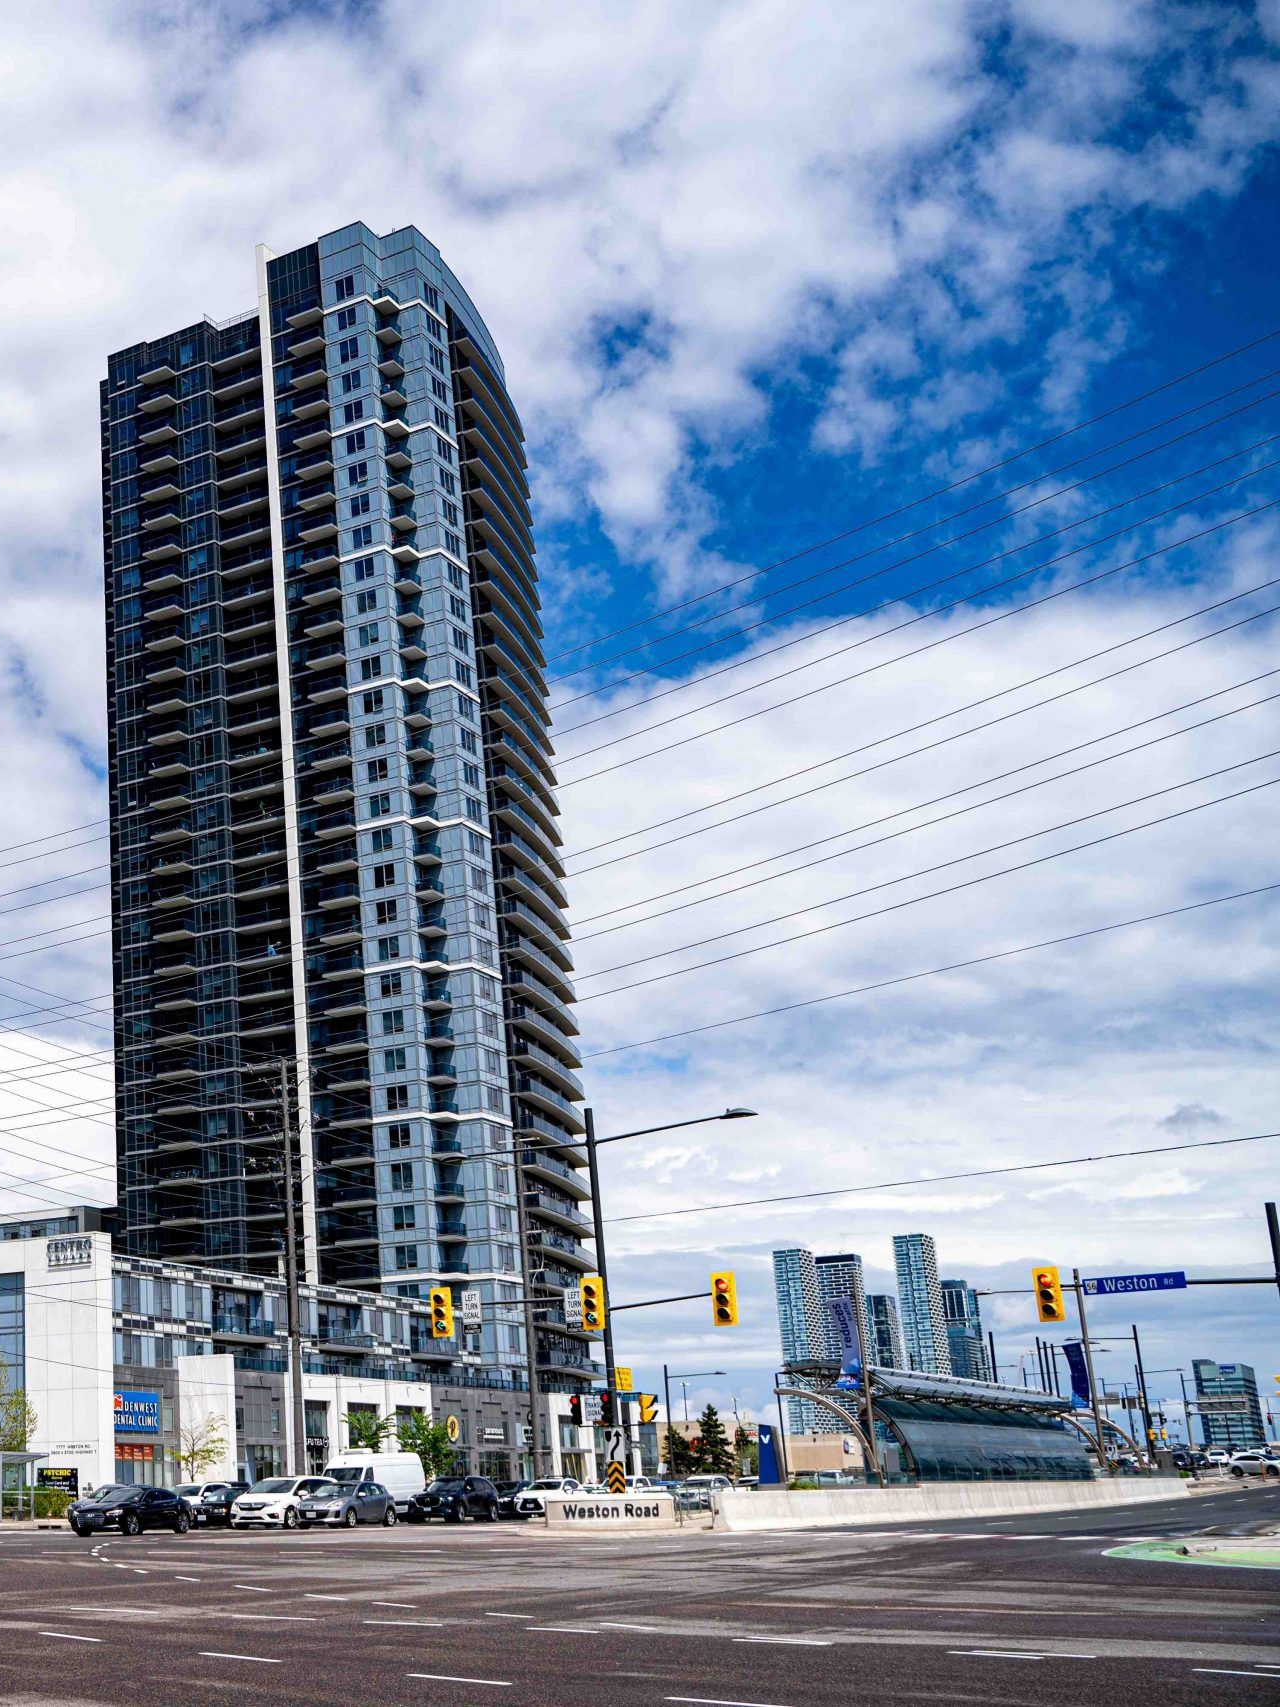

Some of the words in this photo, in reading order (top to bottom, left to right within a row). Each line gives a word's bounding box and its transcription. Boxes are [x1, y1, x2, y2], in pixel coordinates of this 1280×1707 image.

[47, 1239, 92, 1253] CENTRO
[1103, 1276, 1158, 1292] Weston
[1163, 1277, 1174, 1286] Rd
[465, 1293, 477, 1302] LEFT
[567, 1291, 580, 1299] LEFT
[465, 1303, 479, 1311] TURN
[567, 1300, 581, 1308] TURN
[463, 1311, 480, 1319] SIGNAL
[832, 1303, 853, 1349] reduces
[124, 1400, 158, 1414] DENWEST
[113, 1413, 136, 1426] DENTAL
[137, 1415, 158, 1427] CLINIC
[562, 1503, 620, 1520] Weston
[624, 1503, 660, 1518] Road
